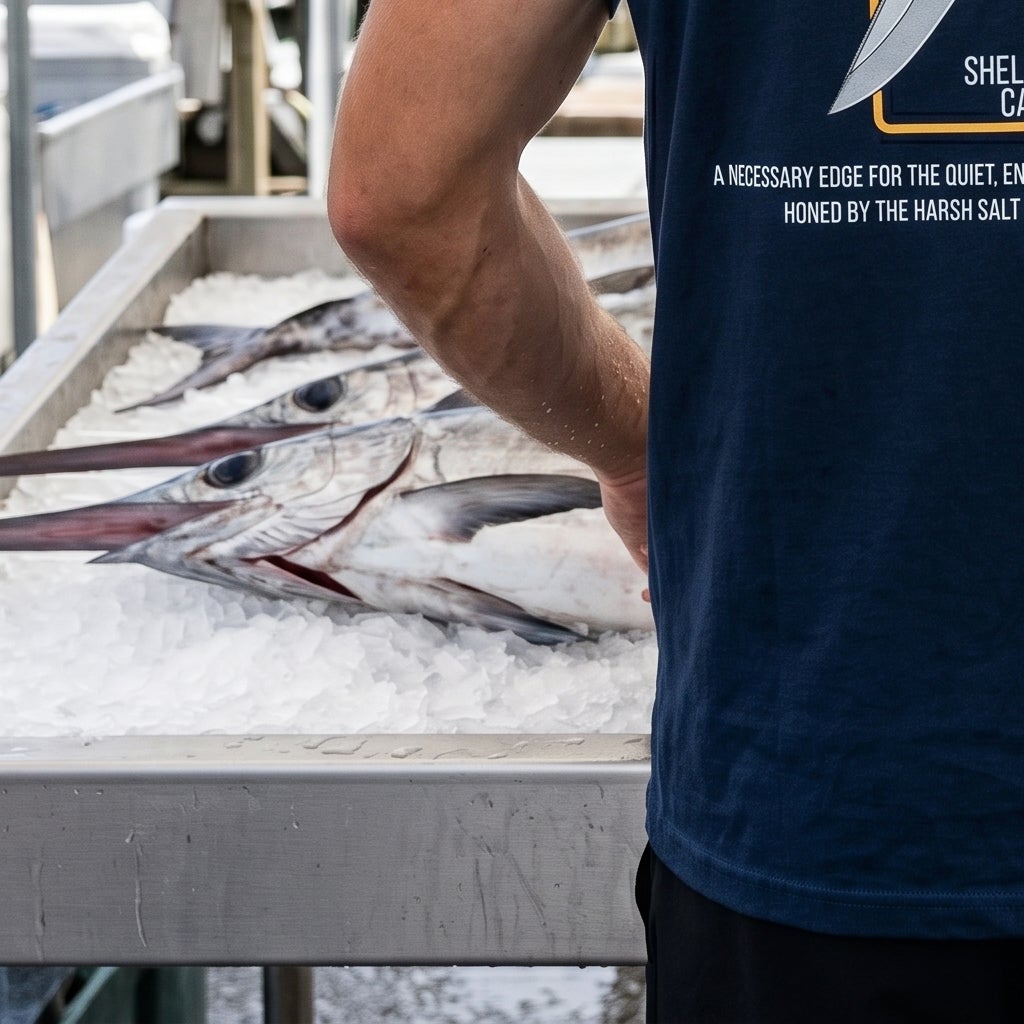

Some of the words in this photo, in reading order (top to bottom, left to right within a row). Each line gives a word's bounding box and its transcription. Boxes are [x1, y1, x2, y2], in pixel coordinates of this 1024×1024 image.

[713, 164, 725, 186] A
[728, 164, 814, 189] NECESSARY
[819, 165, 864, 188] EDGE
[868, 164, 902, 187] FOR
[906, 163, 941, 186] THE
[945, 163, 998, 188] QUIET,
[784, 201, 842, 224] HONED
[847, 200, 871, 223] BY
[875, 199, 909, 222] THE
[914, 198, 973, 221] HARSH
[977, 197, 1021, 221] SALT
